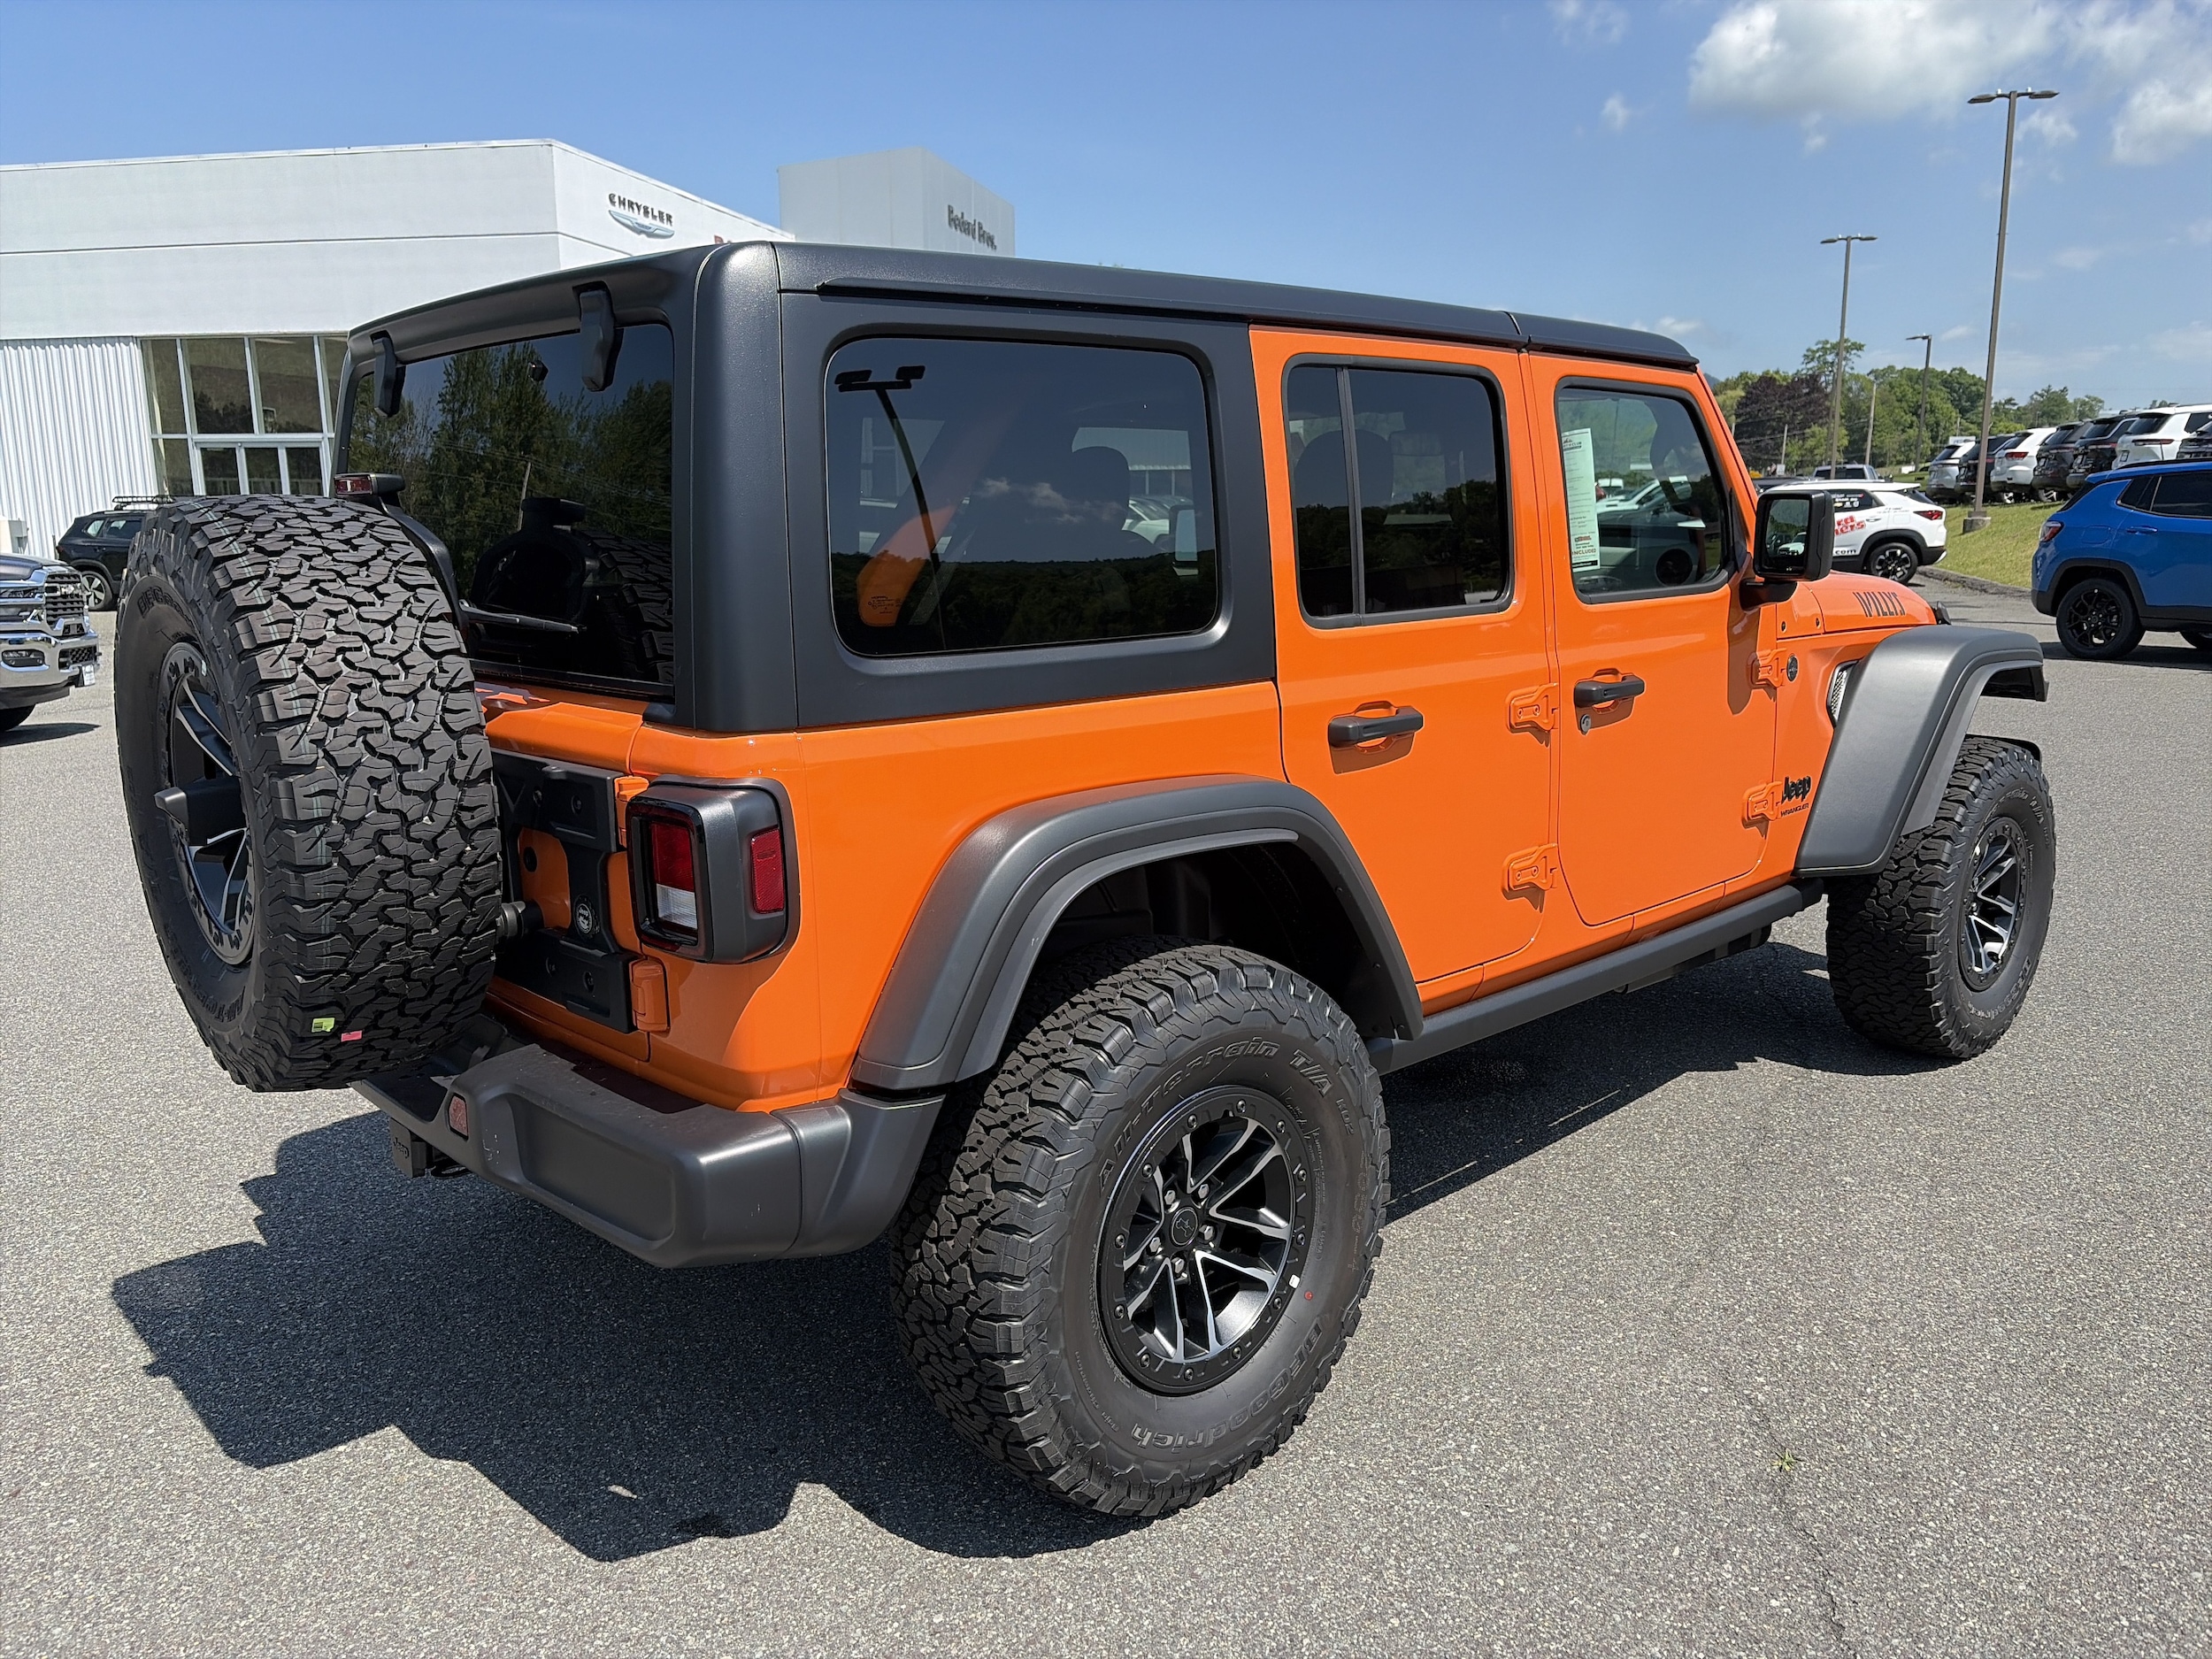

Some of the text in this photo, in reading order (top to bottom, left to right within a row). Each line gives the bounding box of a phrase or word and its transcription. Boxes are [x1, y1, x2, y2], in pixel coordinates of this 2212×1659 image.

[608, 193, 673, 227] CHRYSLER
[1852, 591, 1906, 618] WILLYS
[1781, 775, 1811, 804] Jeep
[1780, 803, 1809, 818] WRANGLER
[1131, 1316, 1324, 1455] BFGoodrich
